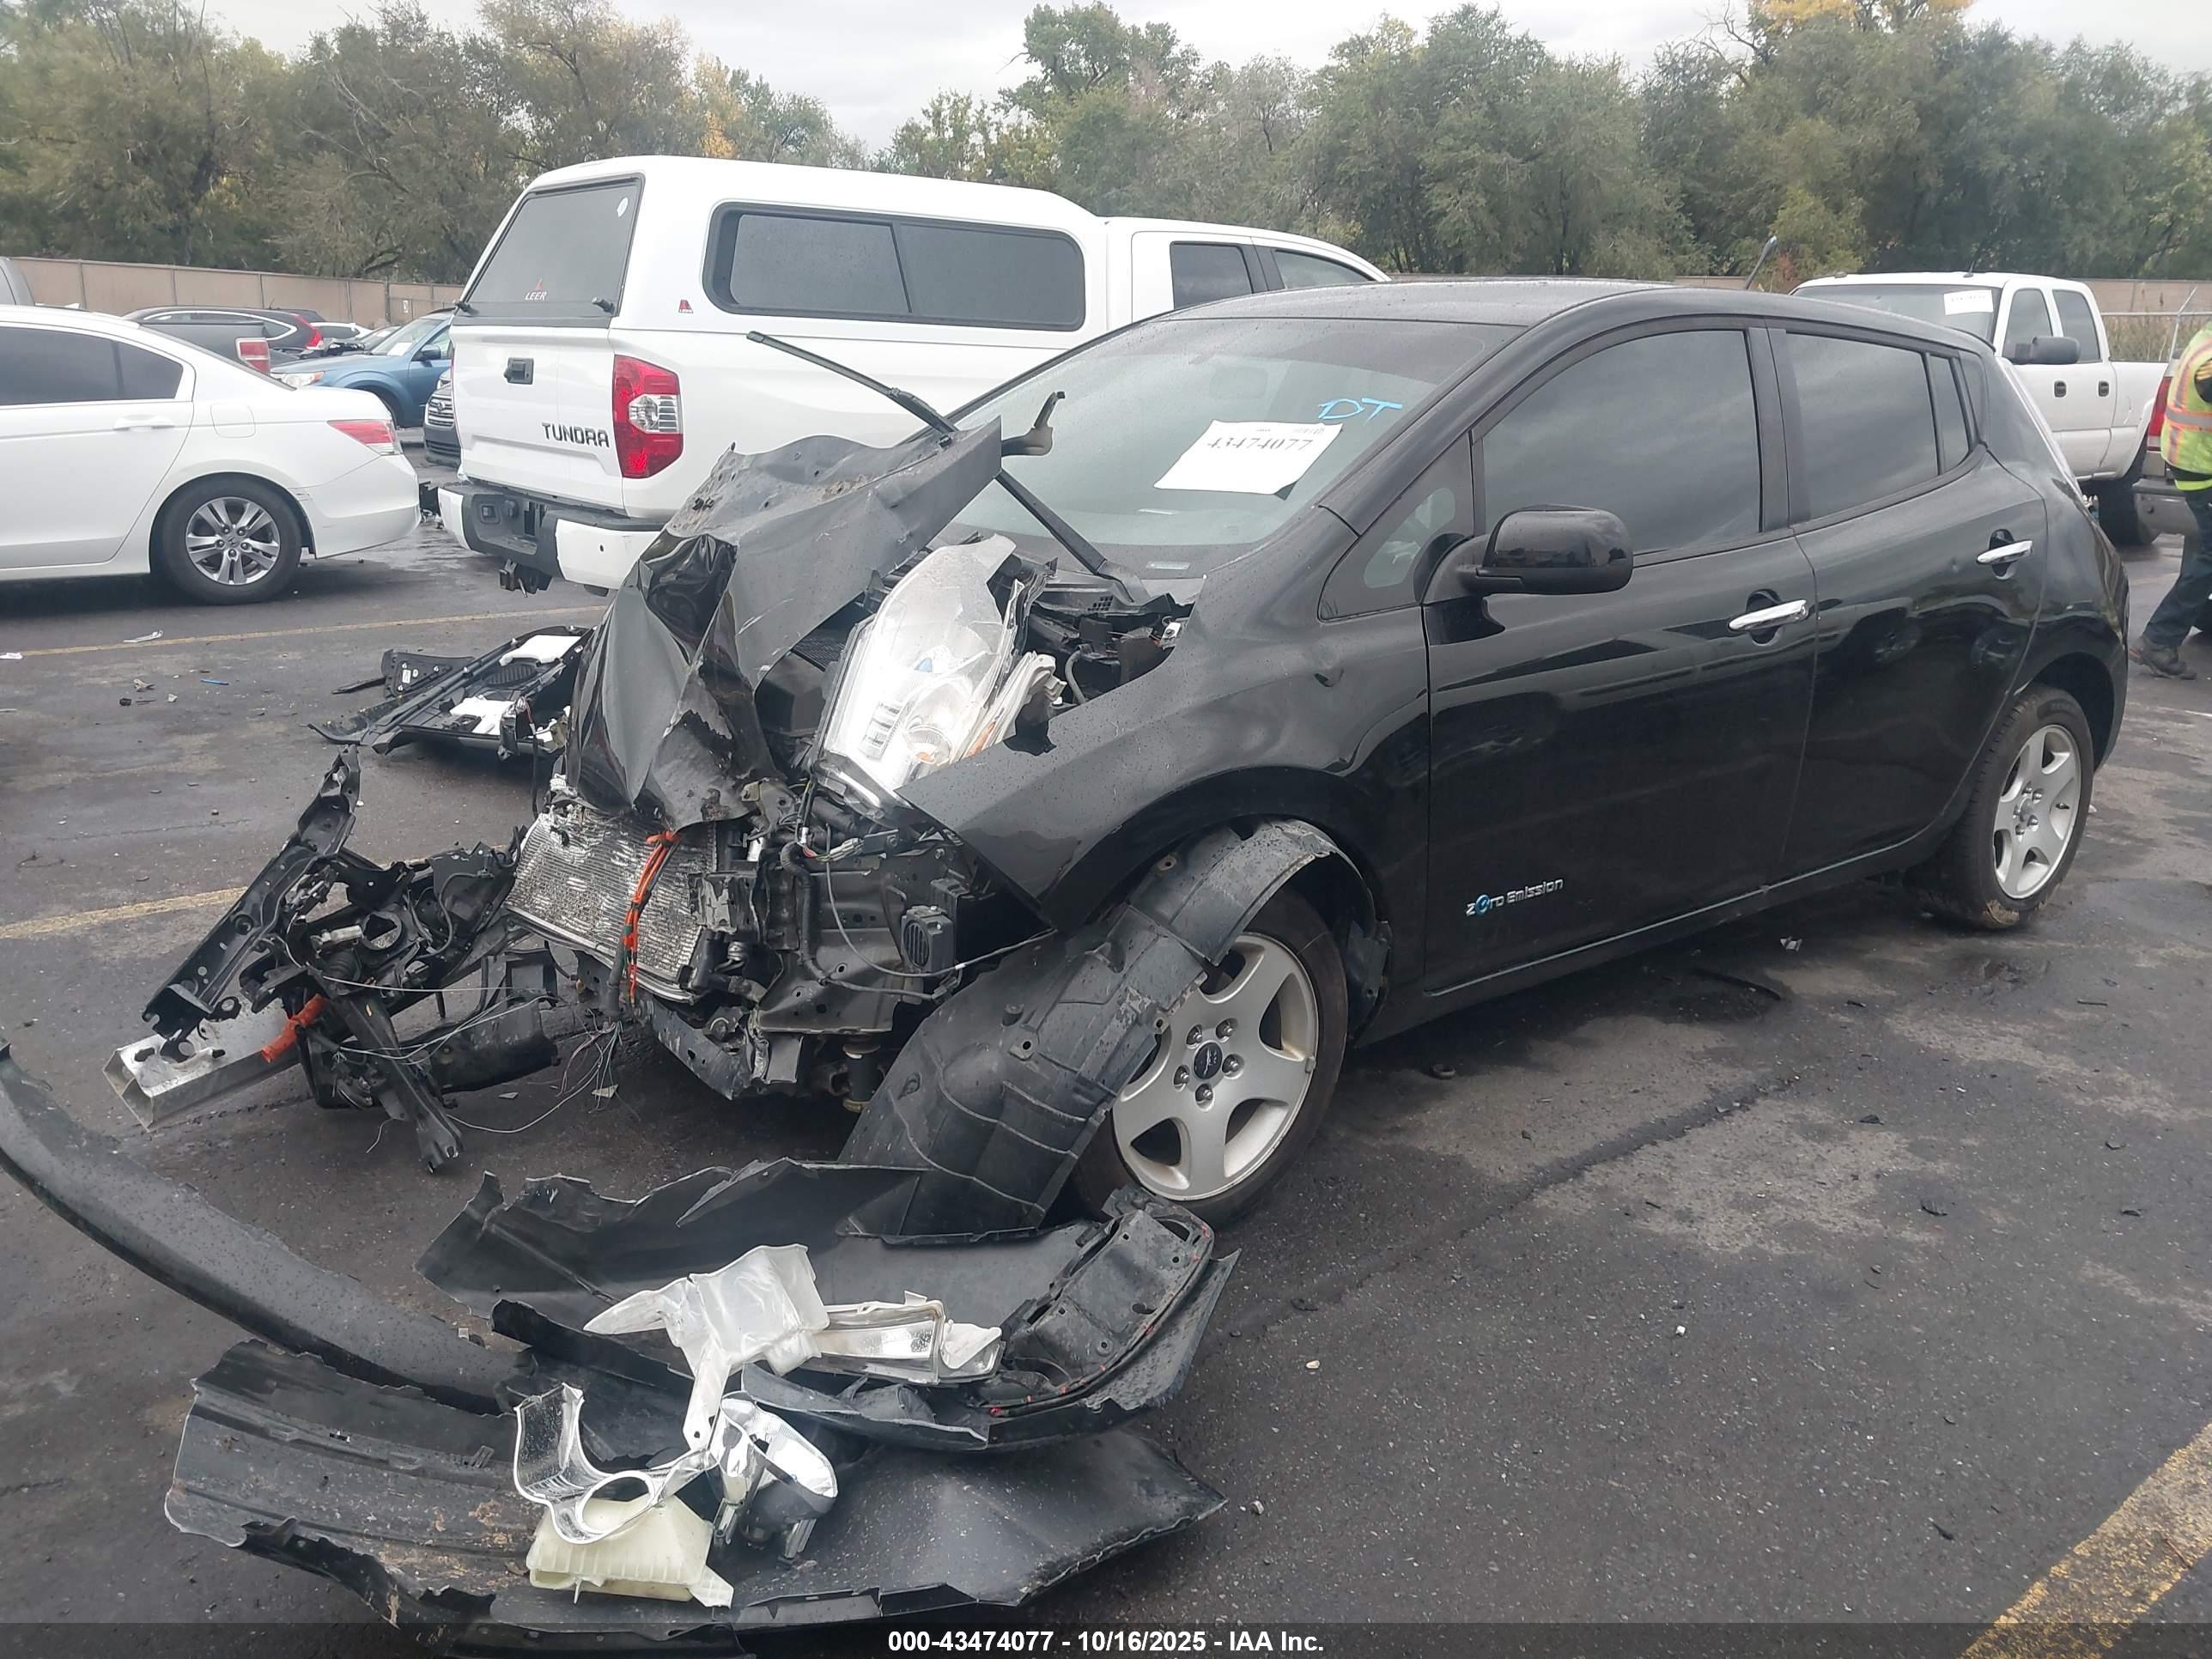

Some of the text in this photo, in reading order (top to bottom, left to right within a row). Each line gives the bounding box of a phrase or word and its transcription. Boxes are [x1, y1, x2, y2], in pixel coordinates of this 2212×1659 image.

[525, 291, 547, 301] LEER
[1318, 398, 1402, 421] DT
[542, 422, 610, 448] TUNDRA
[1207, 437, 1314, 451] 43474077
[1507, 879, 1564, 903] Emission
